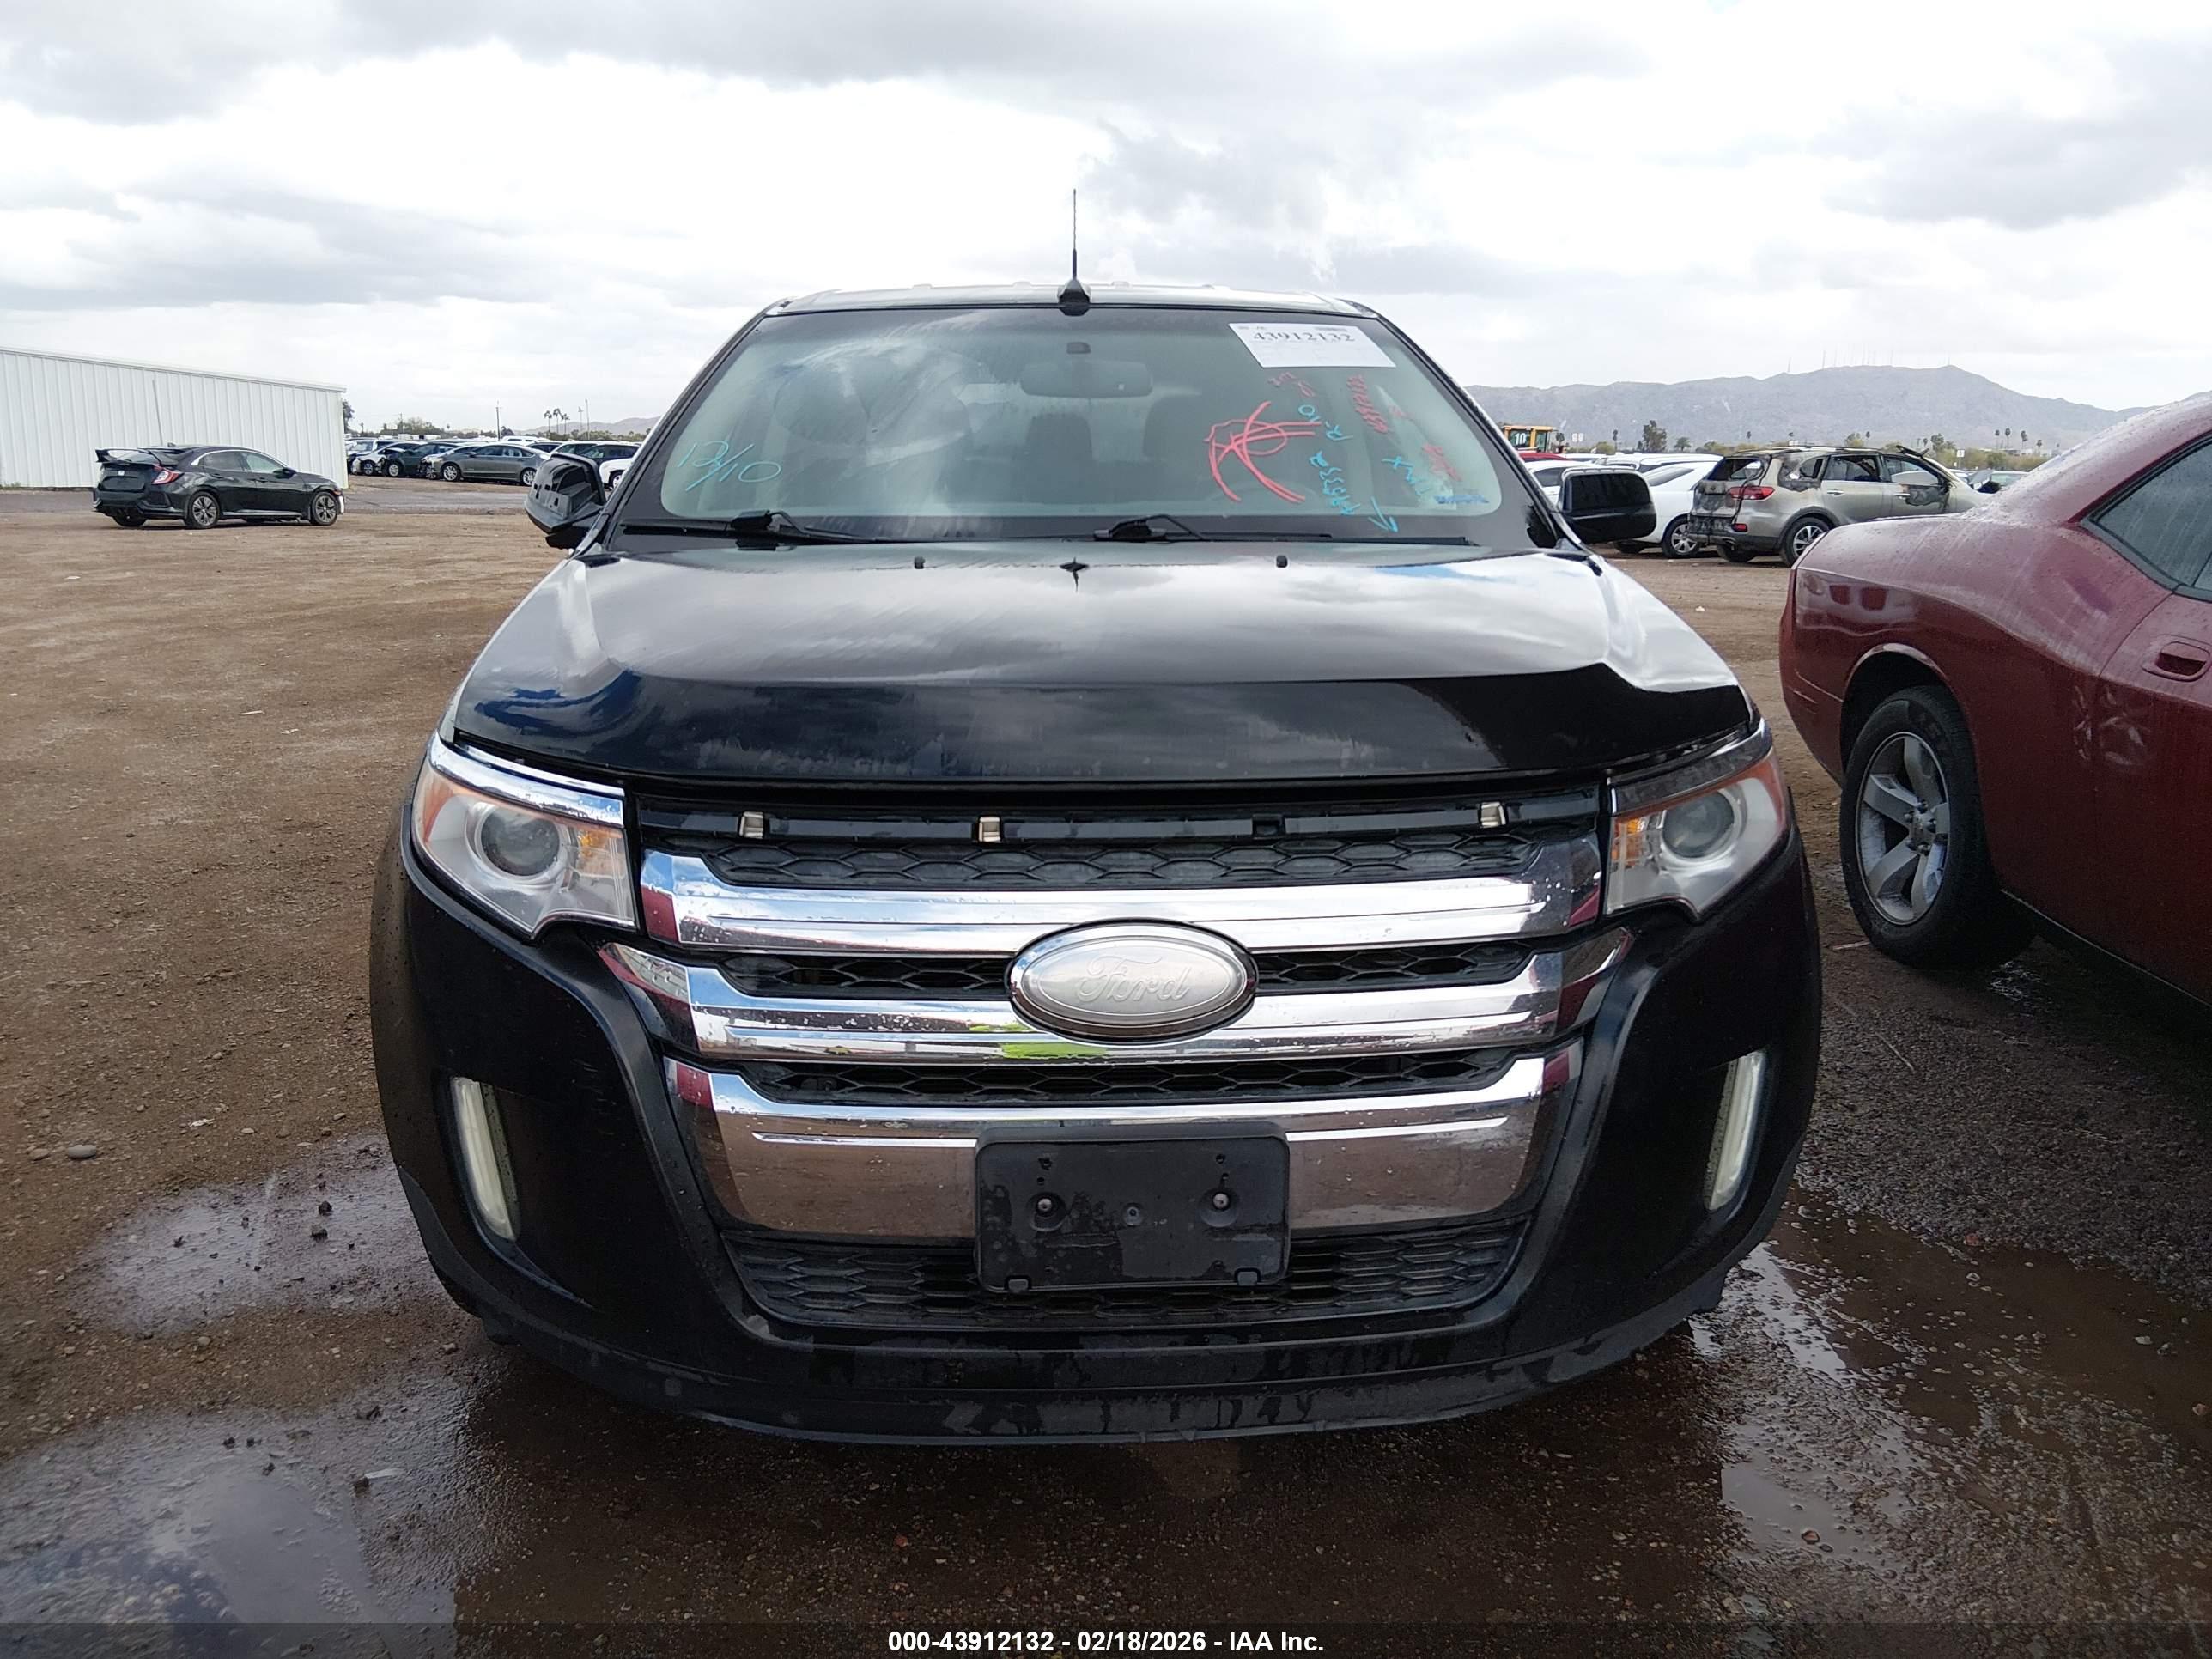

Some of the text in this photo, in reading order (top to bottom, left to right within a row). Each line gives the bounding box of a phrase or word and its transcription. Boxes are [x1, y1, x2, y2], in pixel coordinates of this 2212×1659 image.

[1253, 331, 1355, 342] 43912132
[1515, 432, 1526, 445] 10
[1077, 953, 1190, 1002] Ford
